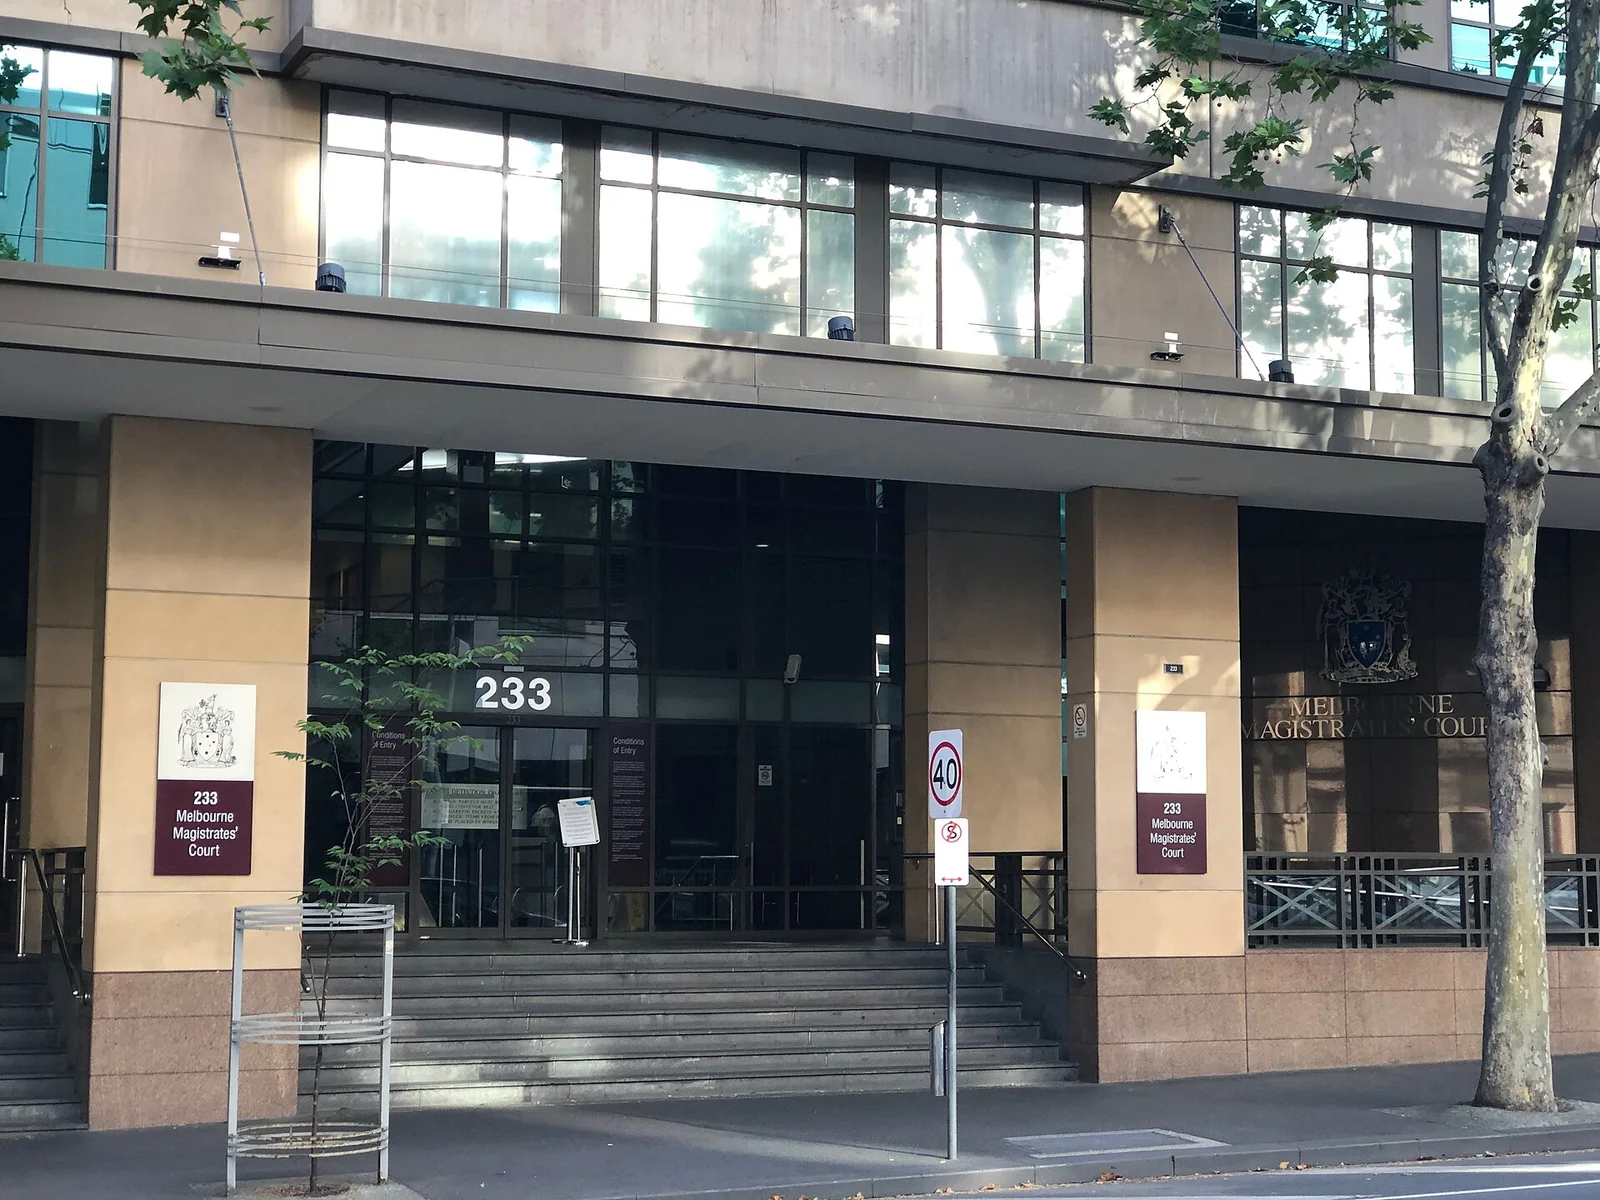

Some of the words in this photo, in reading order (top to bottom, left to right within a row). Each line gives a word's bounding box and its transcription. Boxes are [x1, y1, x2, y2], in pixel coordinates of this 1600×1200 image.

[476, 676, 552, 710] 233
[372, 730, 406, 740] Conditions
[612, 736, 644, 746] Conditions
[380, 740, 396, 750] Entry
[620, 746, 636, 756] Entry
[933, 758, 958, 790] 40
[194, 791, 218, 804] 233
[1164, 802, 1182, 814] 233
[176, 810, 234, 822] Melbourne
[1152, 818, 1193, 829] Melbourne
[173, 826, 238, 842] Magistrates'
[1150, 832, 1196, 846] Magistrates'
[188, 844, 220, 856] Court
[1162, 847, 1184, 858] Court
